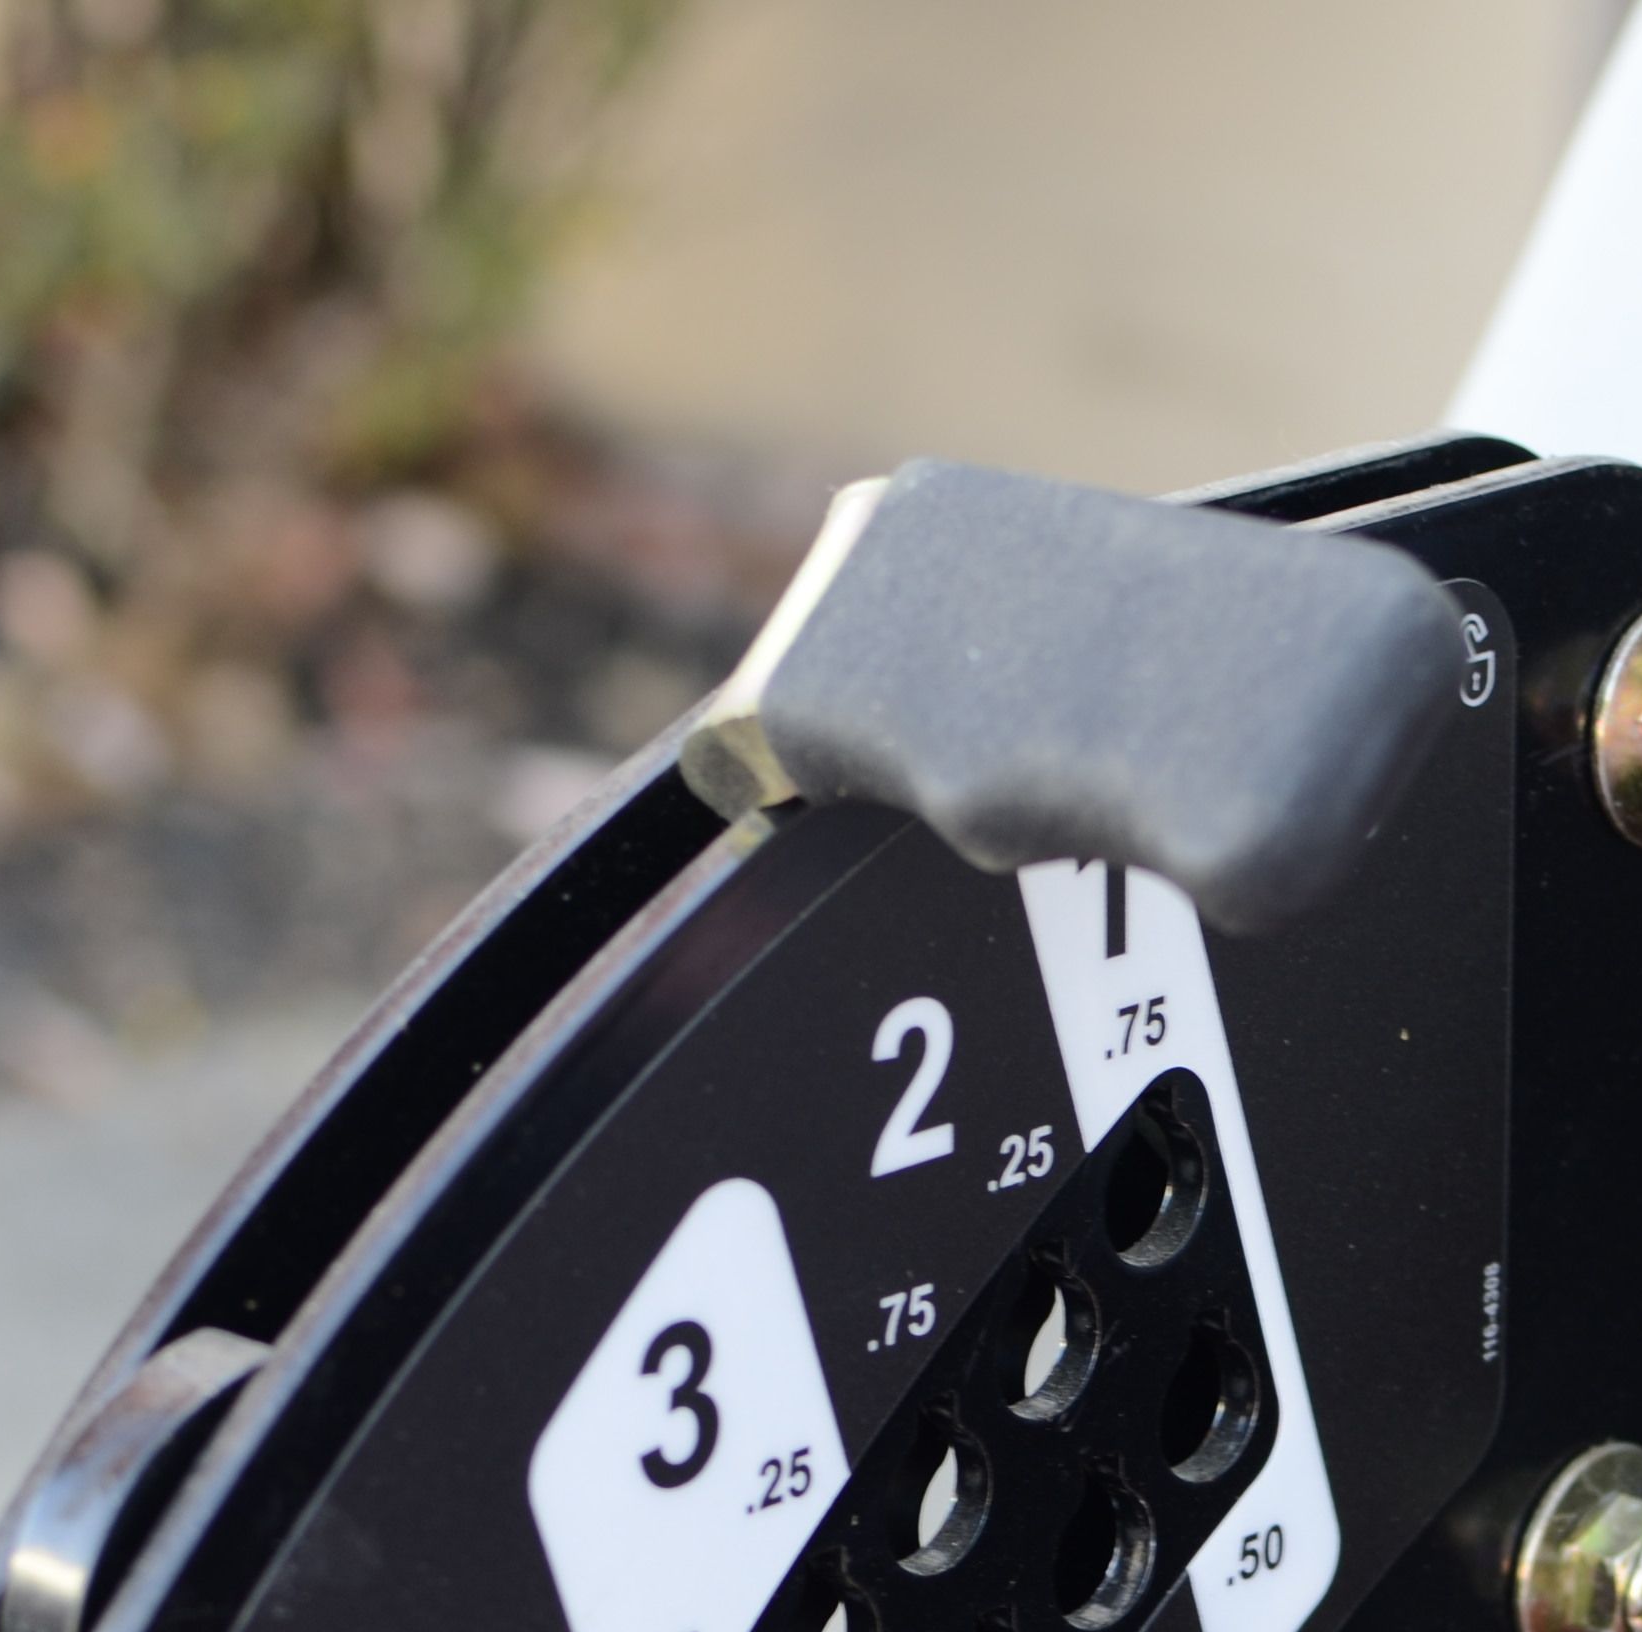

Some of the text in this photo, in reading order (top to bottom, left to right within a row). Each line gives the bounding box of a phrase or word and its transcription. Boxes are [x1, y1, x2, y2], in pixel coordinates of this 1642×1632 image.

[1106, 996, 1166, 1059] .75
[870, 996, 954, 1178] 2
[987, 1125, 1054, 1191] .25
[867, 1283, 936, 1352] .75
[640, 1320, 719, 1489] 3
[747, 1447, 812, 1515] .25
[1226, 1524, 1284, 1586] .50
